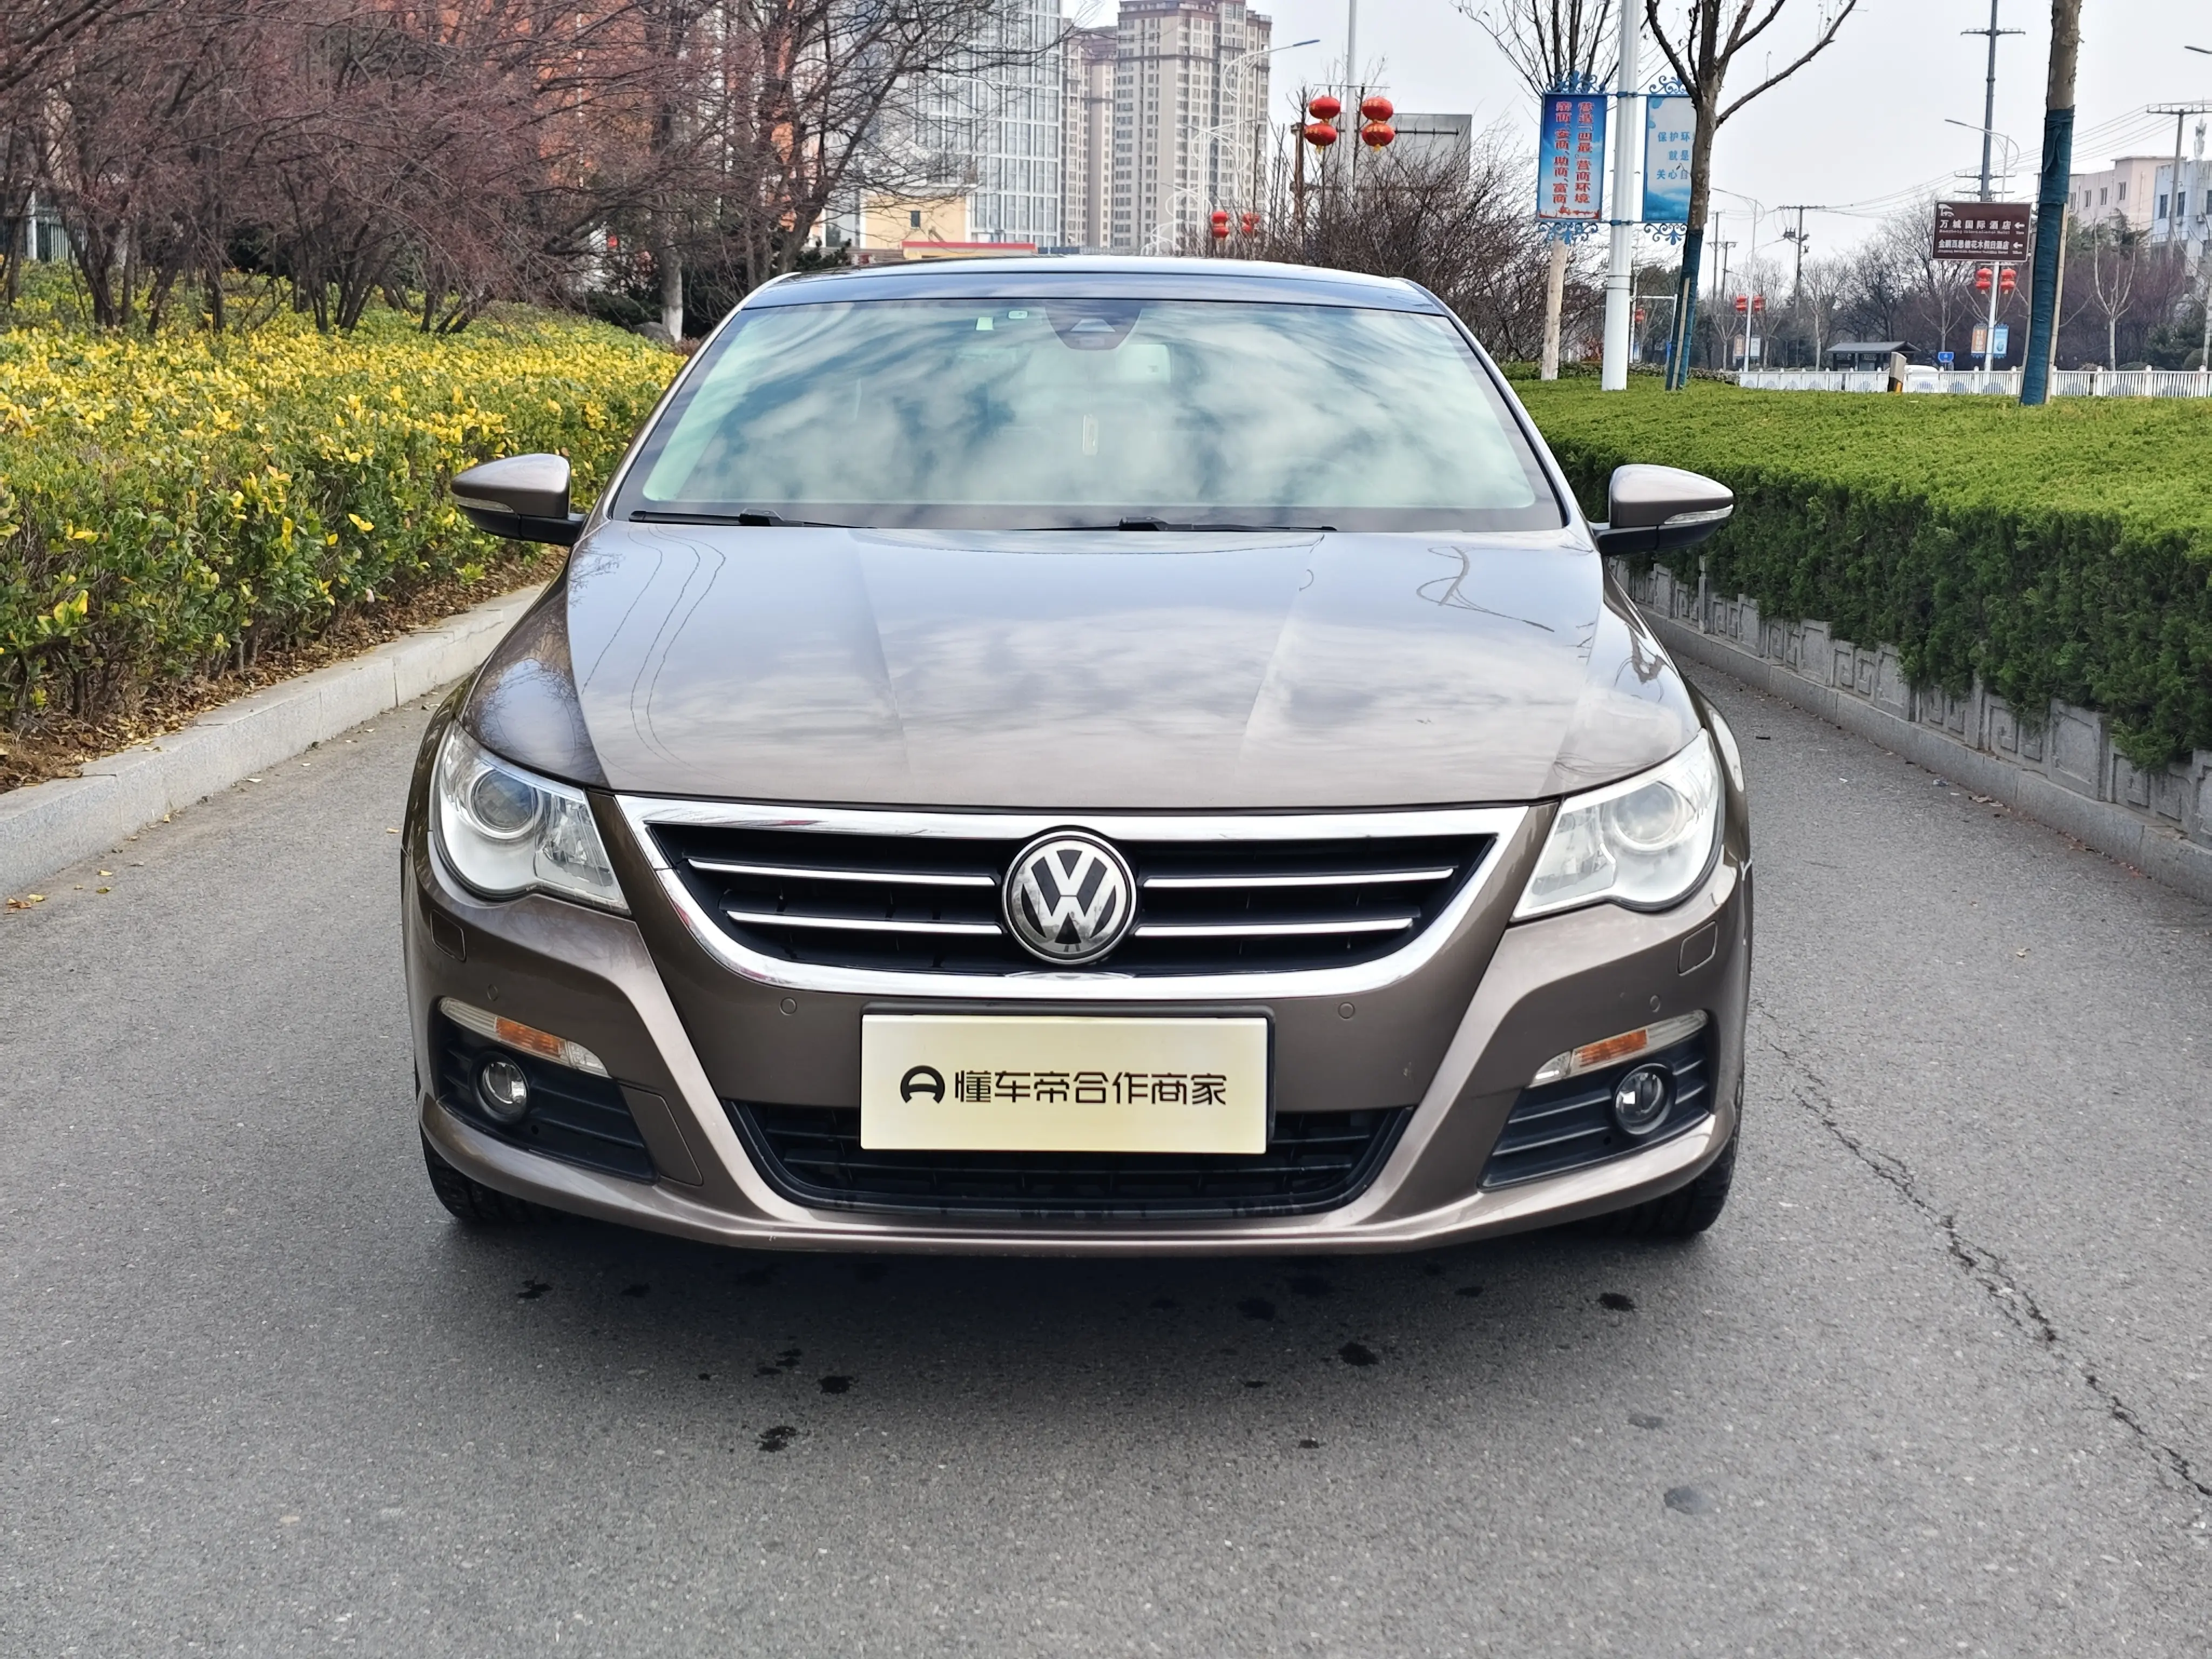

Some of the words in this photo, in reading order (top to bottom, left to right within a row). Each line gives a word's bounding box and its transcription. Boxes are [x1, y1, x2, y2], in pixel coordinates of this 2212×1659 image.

[1668, 150, 1689, 161] 就是
[954, 1069, 1228, 1105] 懂车帝合作商家
